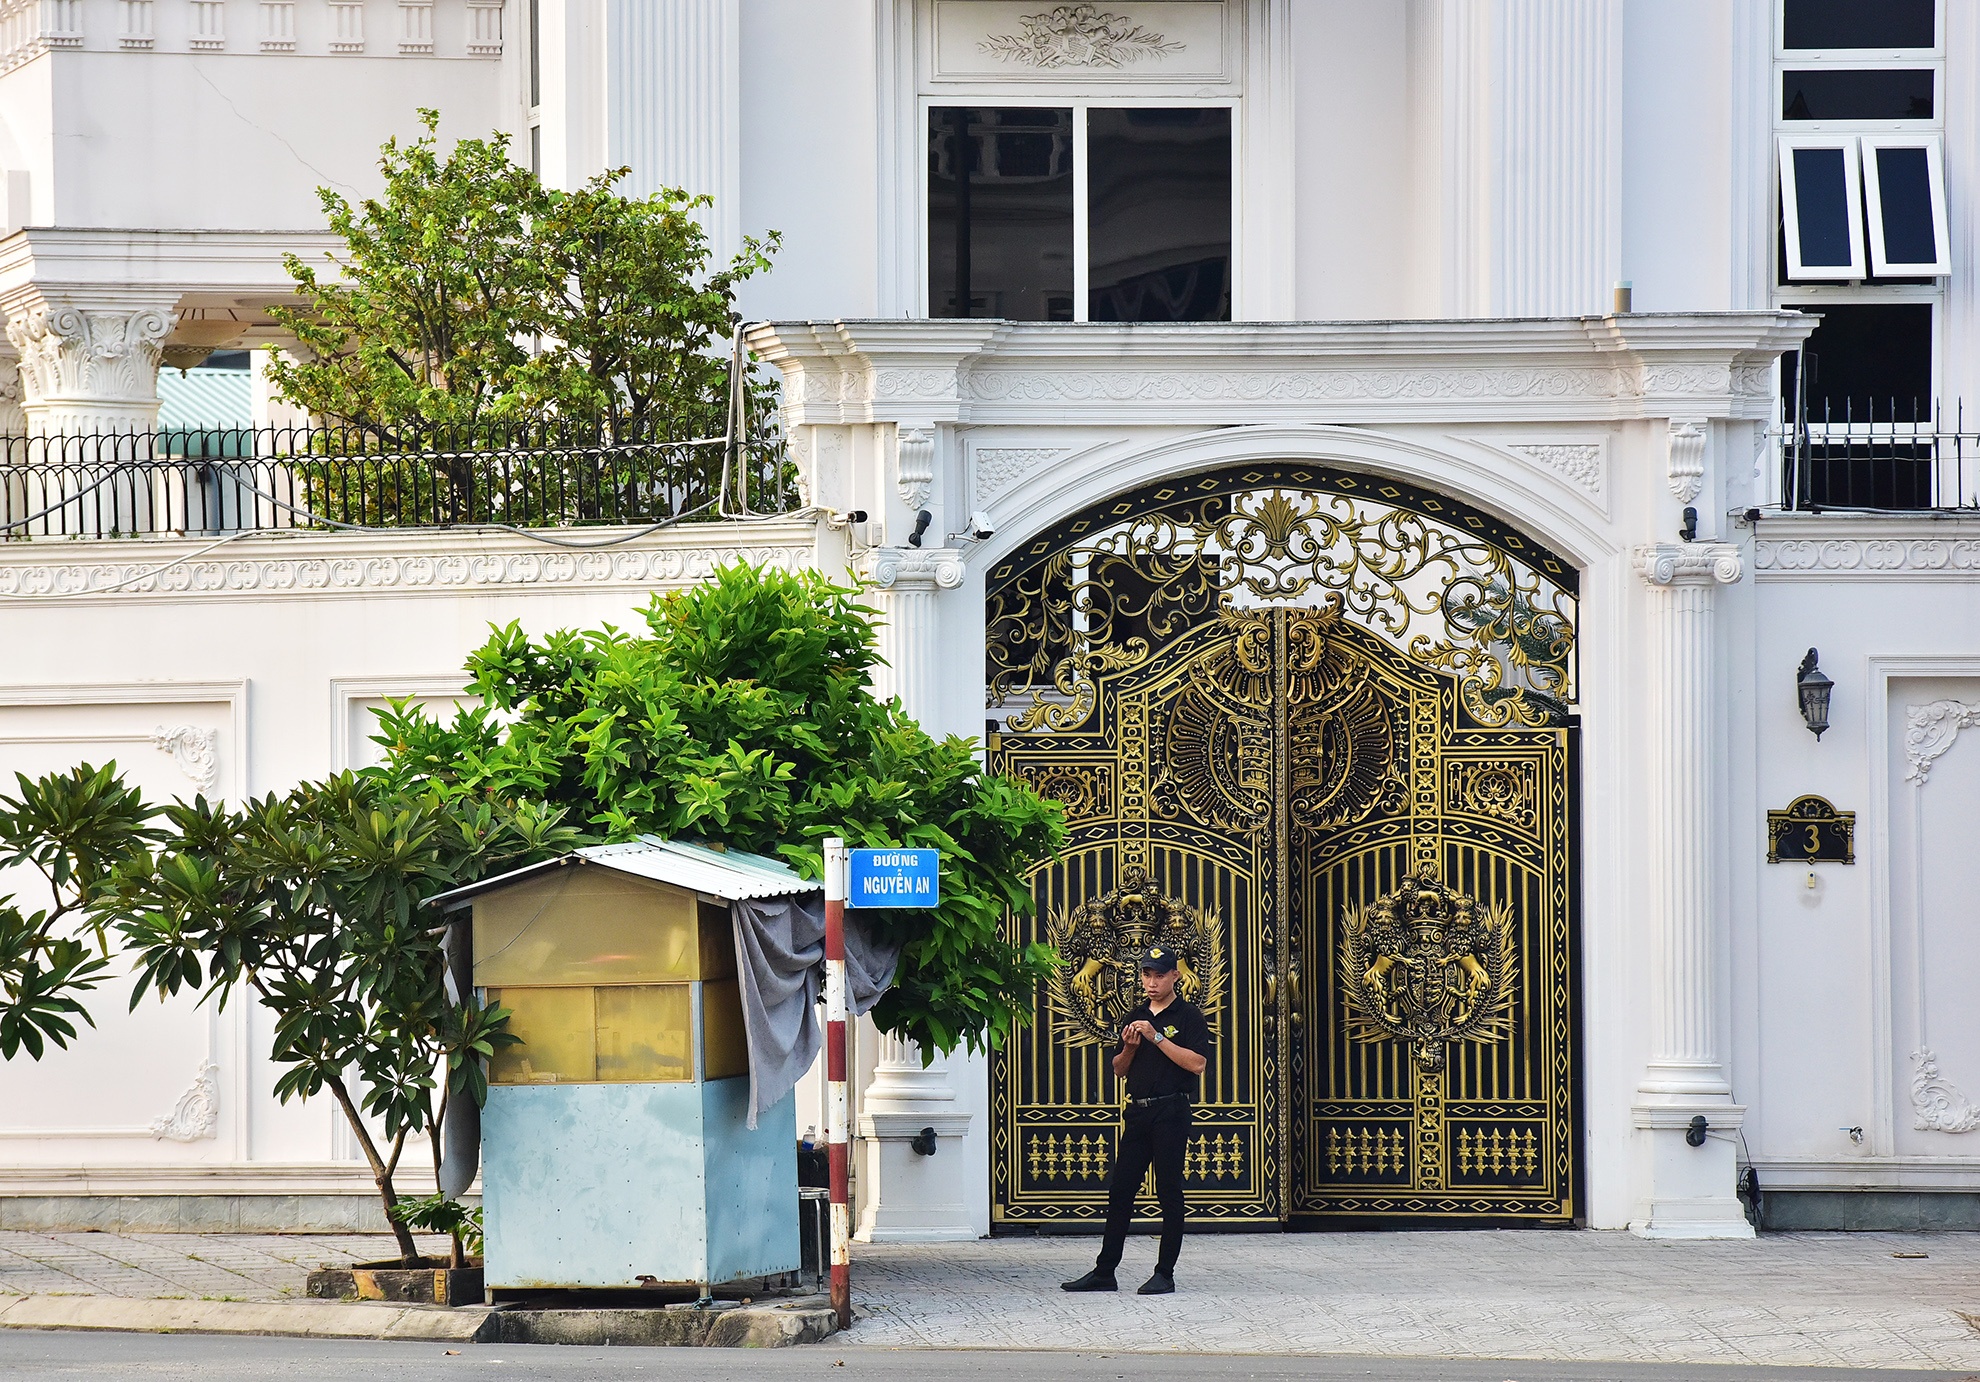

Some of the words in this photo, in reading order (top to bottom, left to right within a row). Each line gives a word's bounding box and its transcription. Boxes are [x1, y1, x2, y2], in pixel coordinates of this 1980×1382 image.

[1803, 824, 1820, 853] 3
[873, 851, 918, 867] ĐƯỜNG
[863, 869, 912, 894] NGUYỄN
[915, 876, 930, 894] AN
